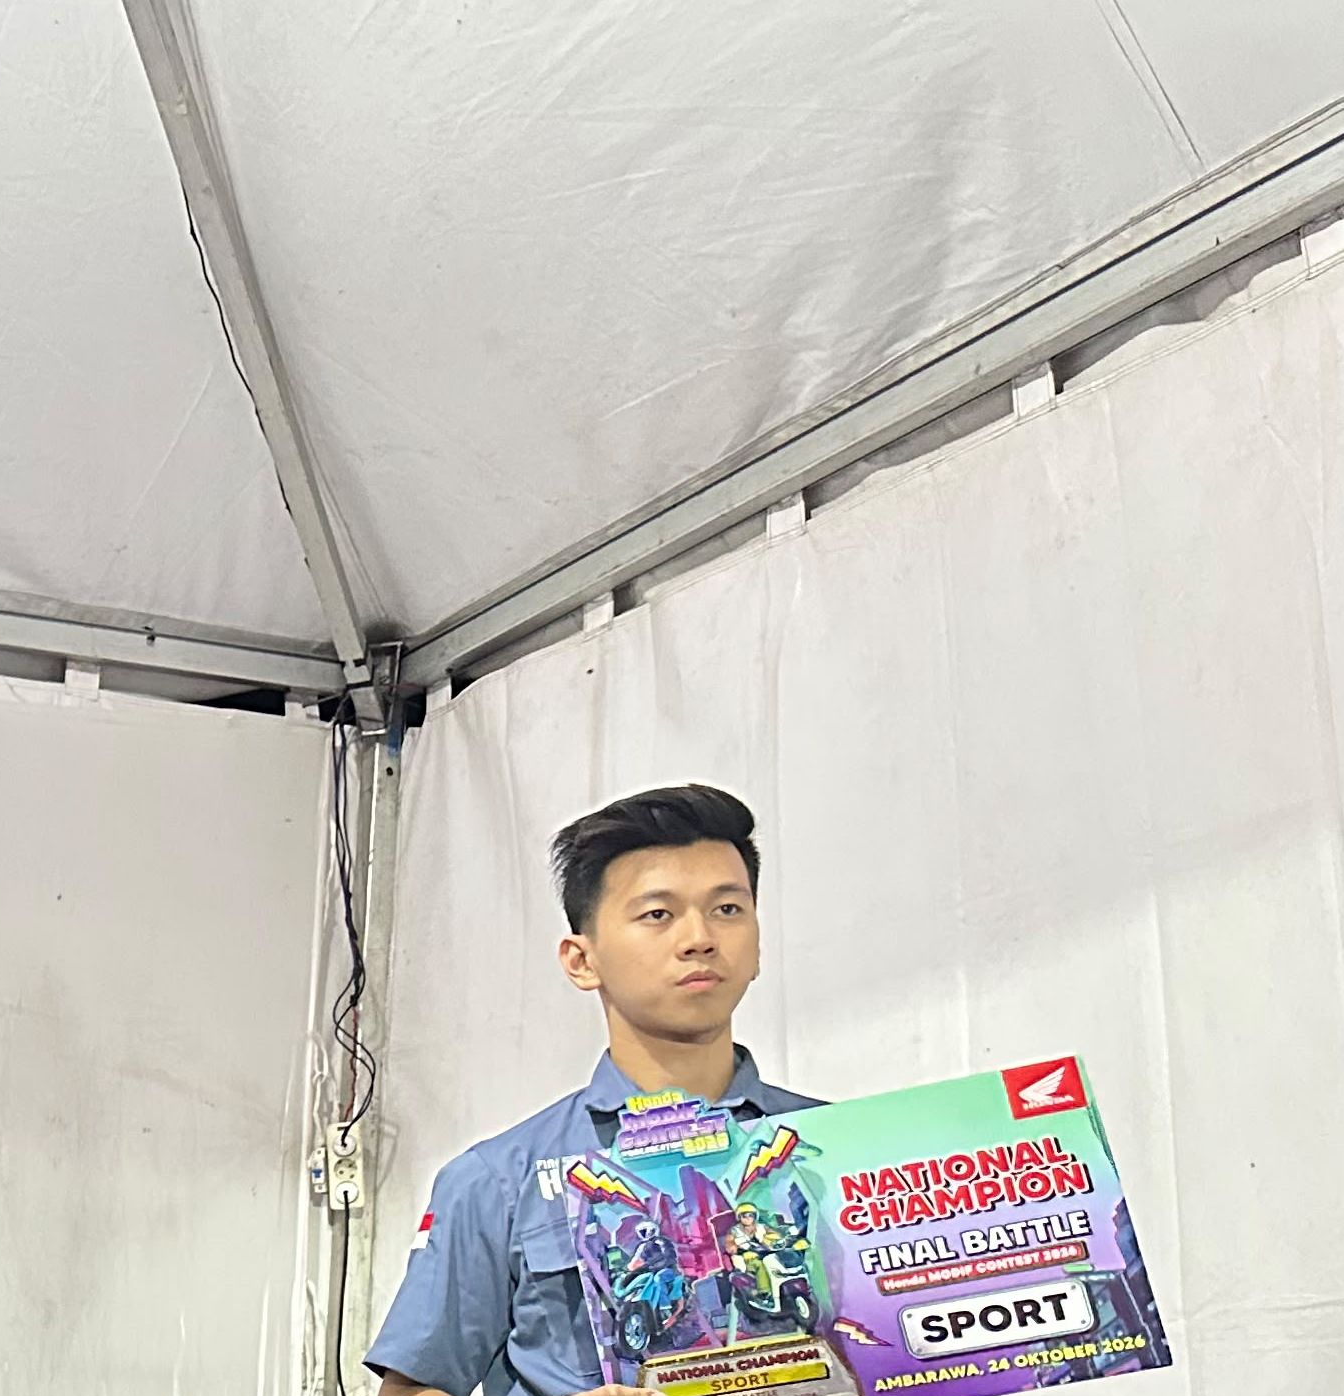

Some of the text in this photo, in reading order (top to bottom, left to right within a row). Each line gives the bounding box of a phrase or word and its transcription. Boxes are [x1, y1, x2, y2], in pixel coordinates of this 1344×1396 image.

[839, 1137, 1070, 1203] NATIONAL
[838, 1163, 1088, 1233] CHAMPION
[859, 1210, 1093, 1274] FINAL BATTLE
[975, 1254, 1041, 1275] CONTEST
[920, 1292, 1069, 1344] SPORT
[657, 1362, 735, 1384] NATIONAL
[710, 1372, 770, 1392] SPORT
[874, 1334, 1146, 1393] AMBARAWA, 24 OKTOBER 2026
